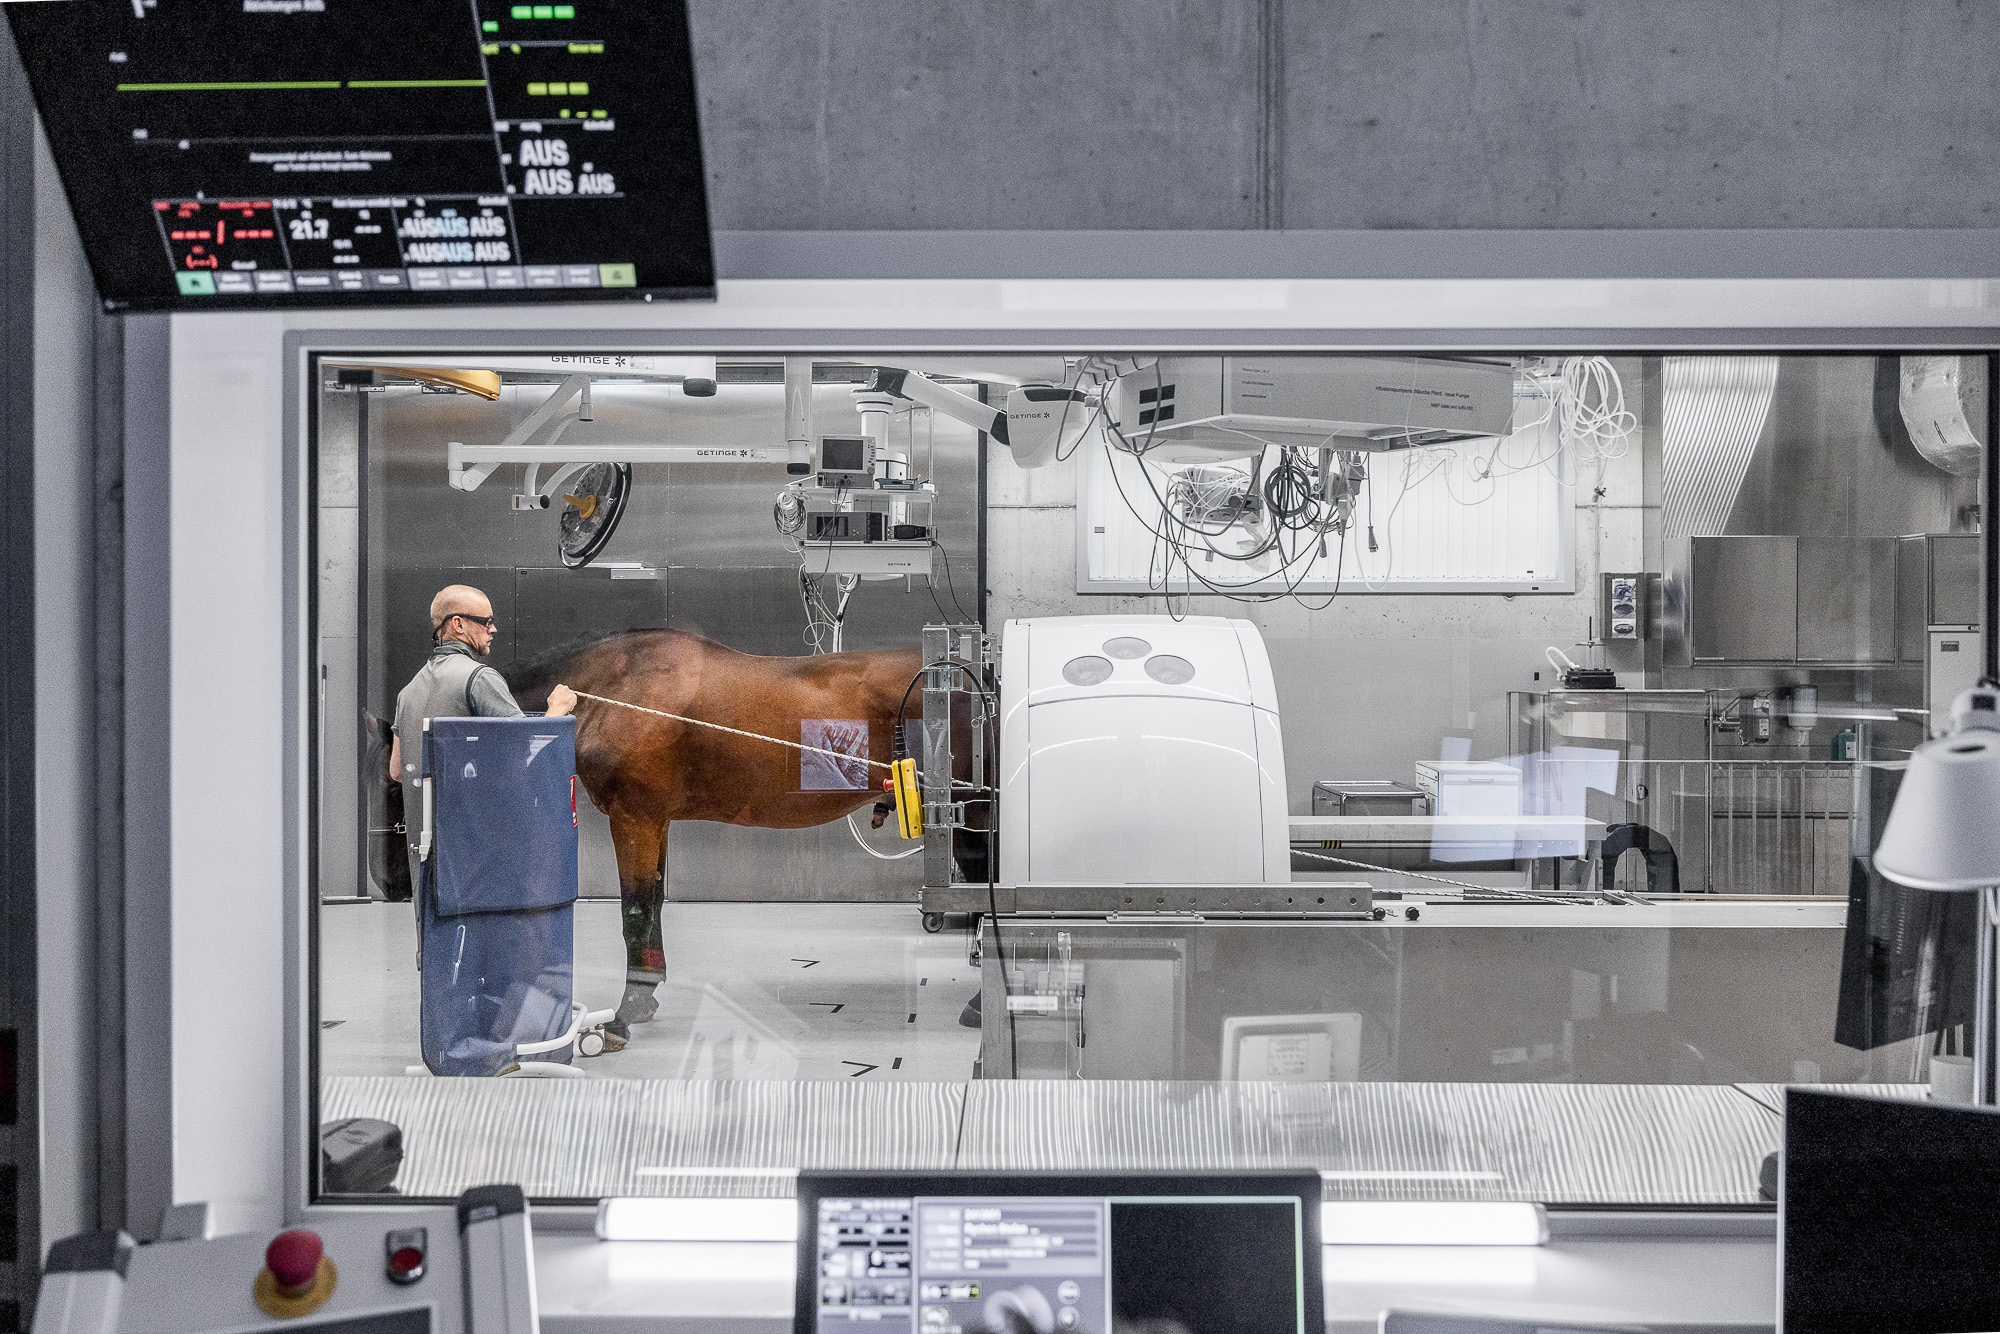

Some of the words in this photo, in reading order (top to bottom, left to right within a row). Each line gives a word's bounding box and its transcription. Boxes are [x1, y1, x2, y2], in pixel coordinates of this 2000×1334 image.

[520, 139, 570, 166] AUS
[524, 168, 574, 195] AUS
[578, 173, 616, 195] AUS
[403, 217, 438, 238] AUS
[435, 217, 470, 237] AUS
[470, 216, 506, 237] AUS
[408, 243, 444, 263] AUS
[440, 242, 474, 262] AUS
[474, 241, 511, 262] AUS
[551, 356, 610, 365] GETINGE
